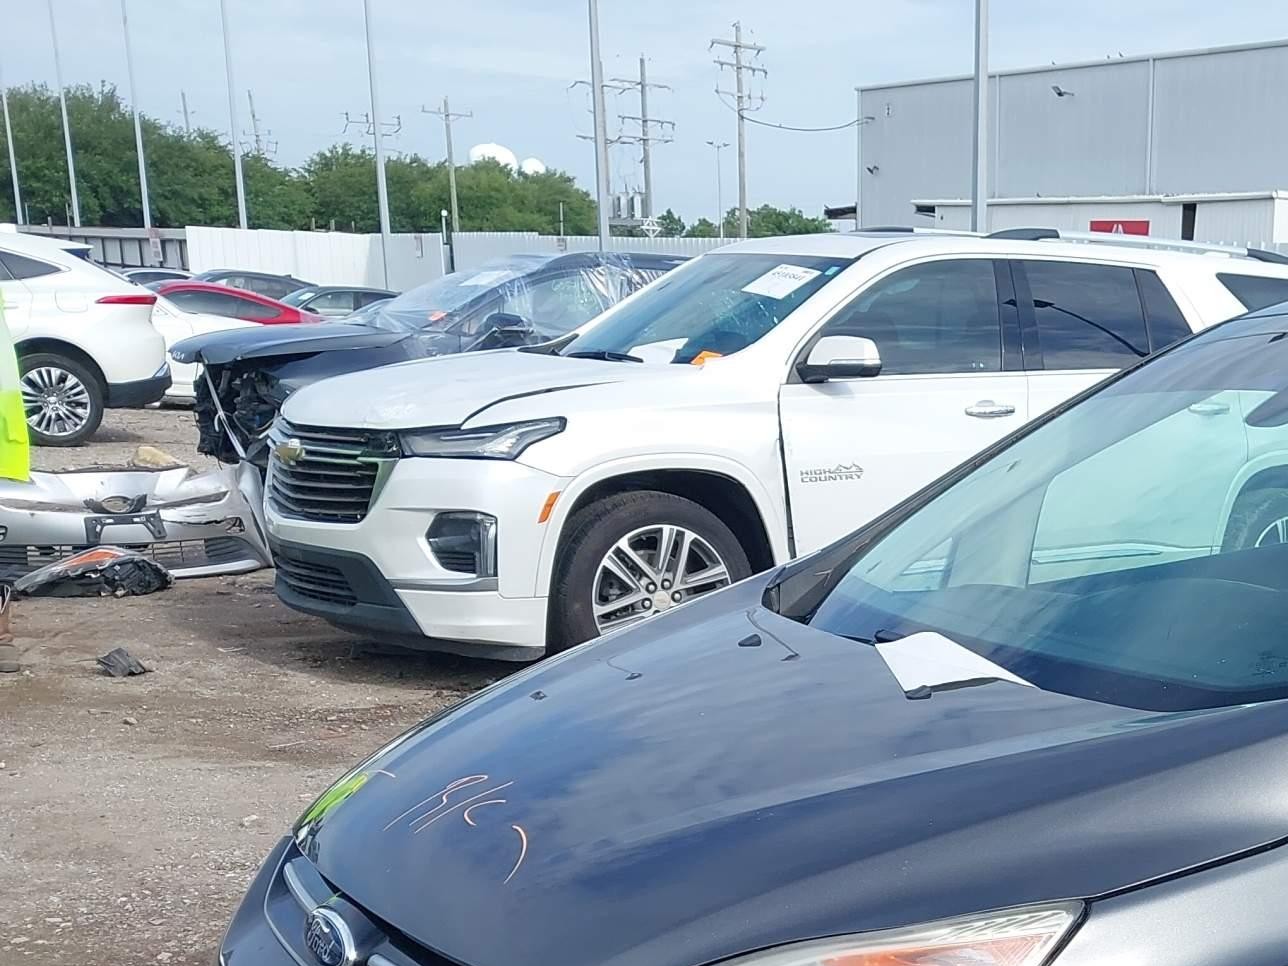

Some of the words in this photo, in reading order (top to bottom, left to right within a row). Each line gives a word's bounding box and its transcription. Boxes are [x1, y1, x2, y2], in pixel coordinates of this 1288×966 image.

[799, 468, 833, 477] HIGH
[800, 473, 863, 483] COUNTRY
[306, 917, 335, 963] Ford
